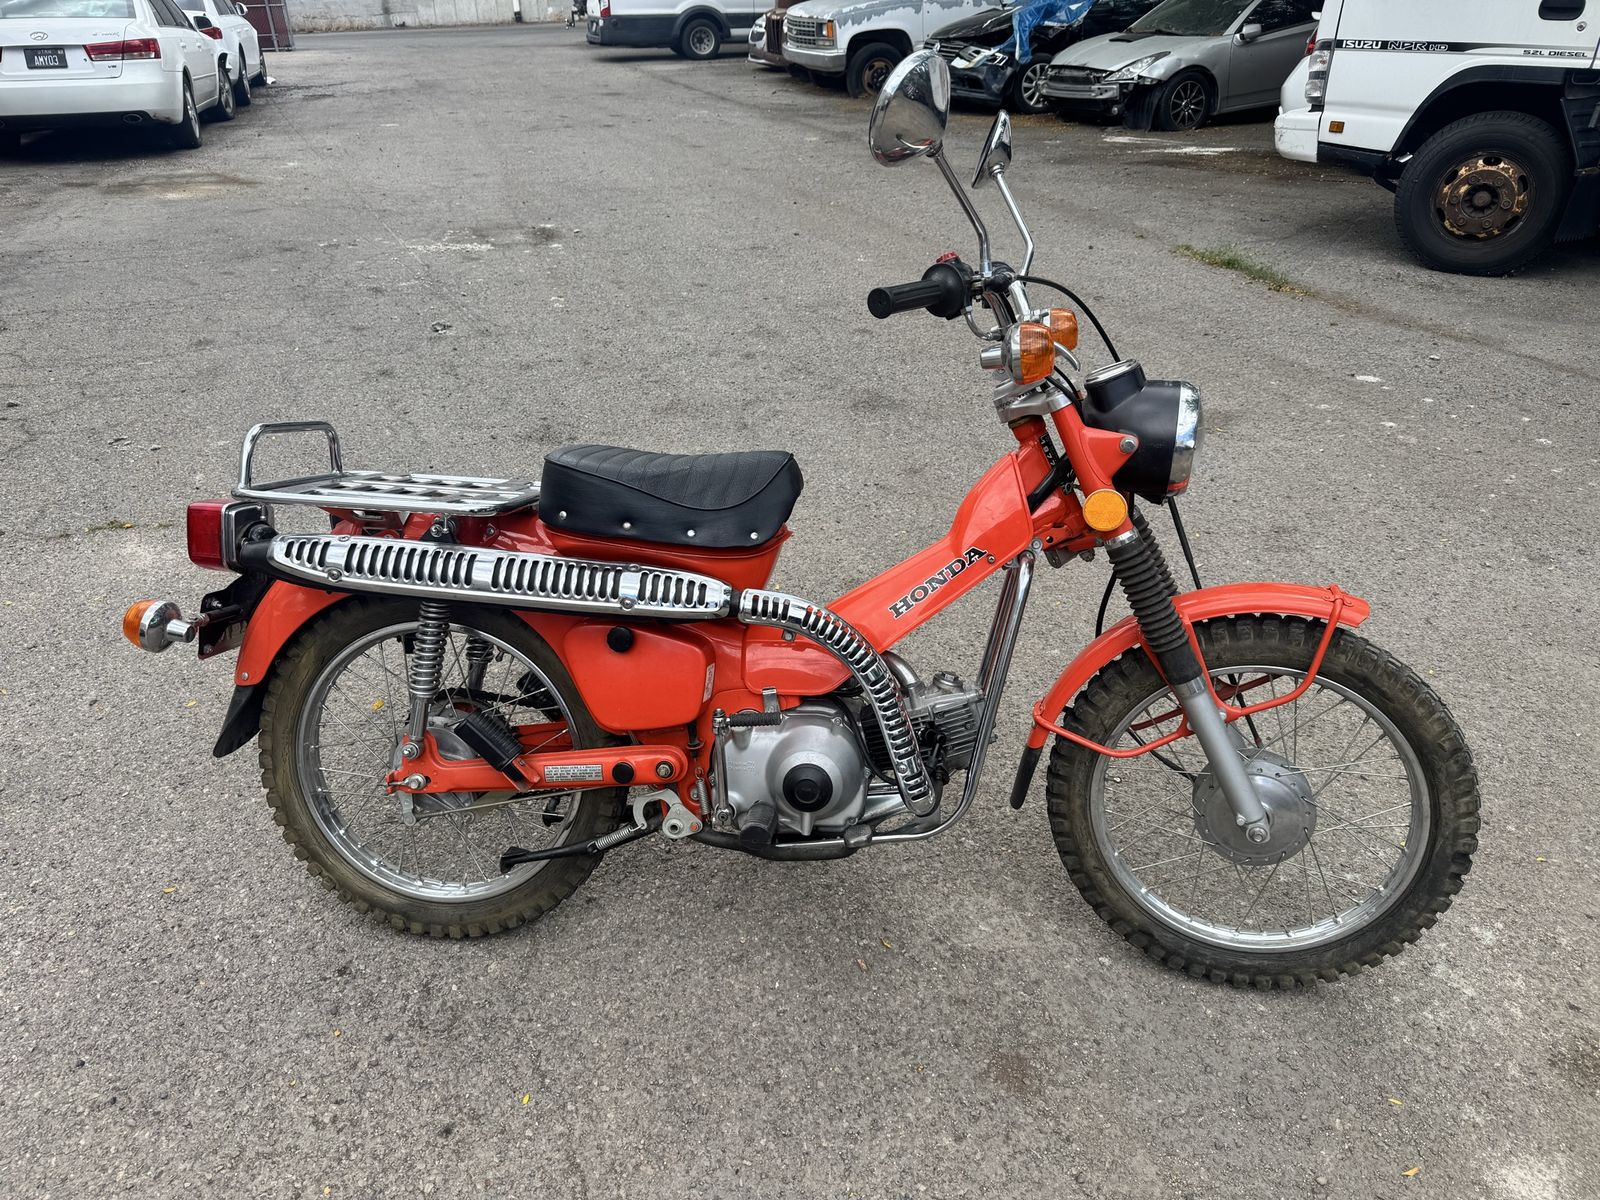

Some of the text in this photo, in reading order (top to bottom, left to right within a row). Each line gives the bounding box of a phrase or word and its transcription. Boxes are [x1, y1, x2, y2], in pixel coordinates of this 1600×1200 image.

[1342, 40, 1381, 49] ISUZU
[1428, 43, 1449, 51] HD
[1548, 50, 1588, 58] DIESEL
[34, 55, 59, 66] AMY03
[888, 546, 988, 619] HONDA
